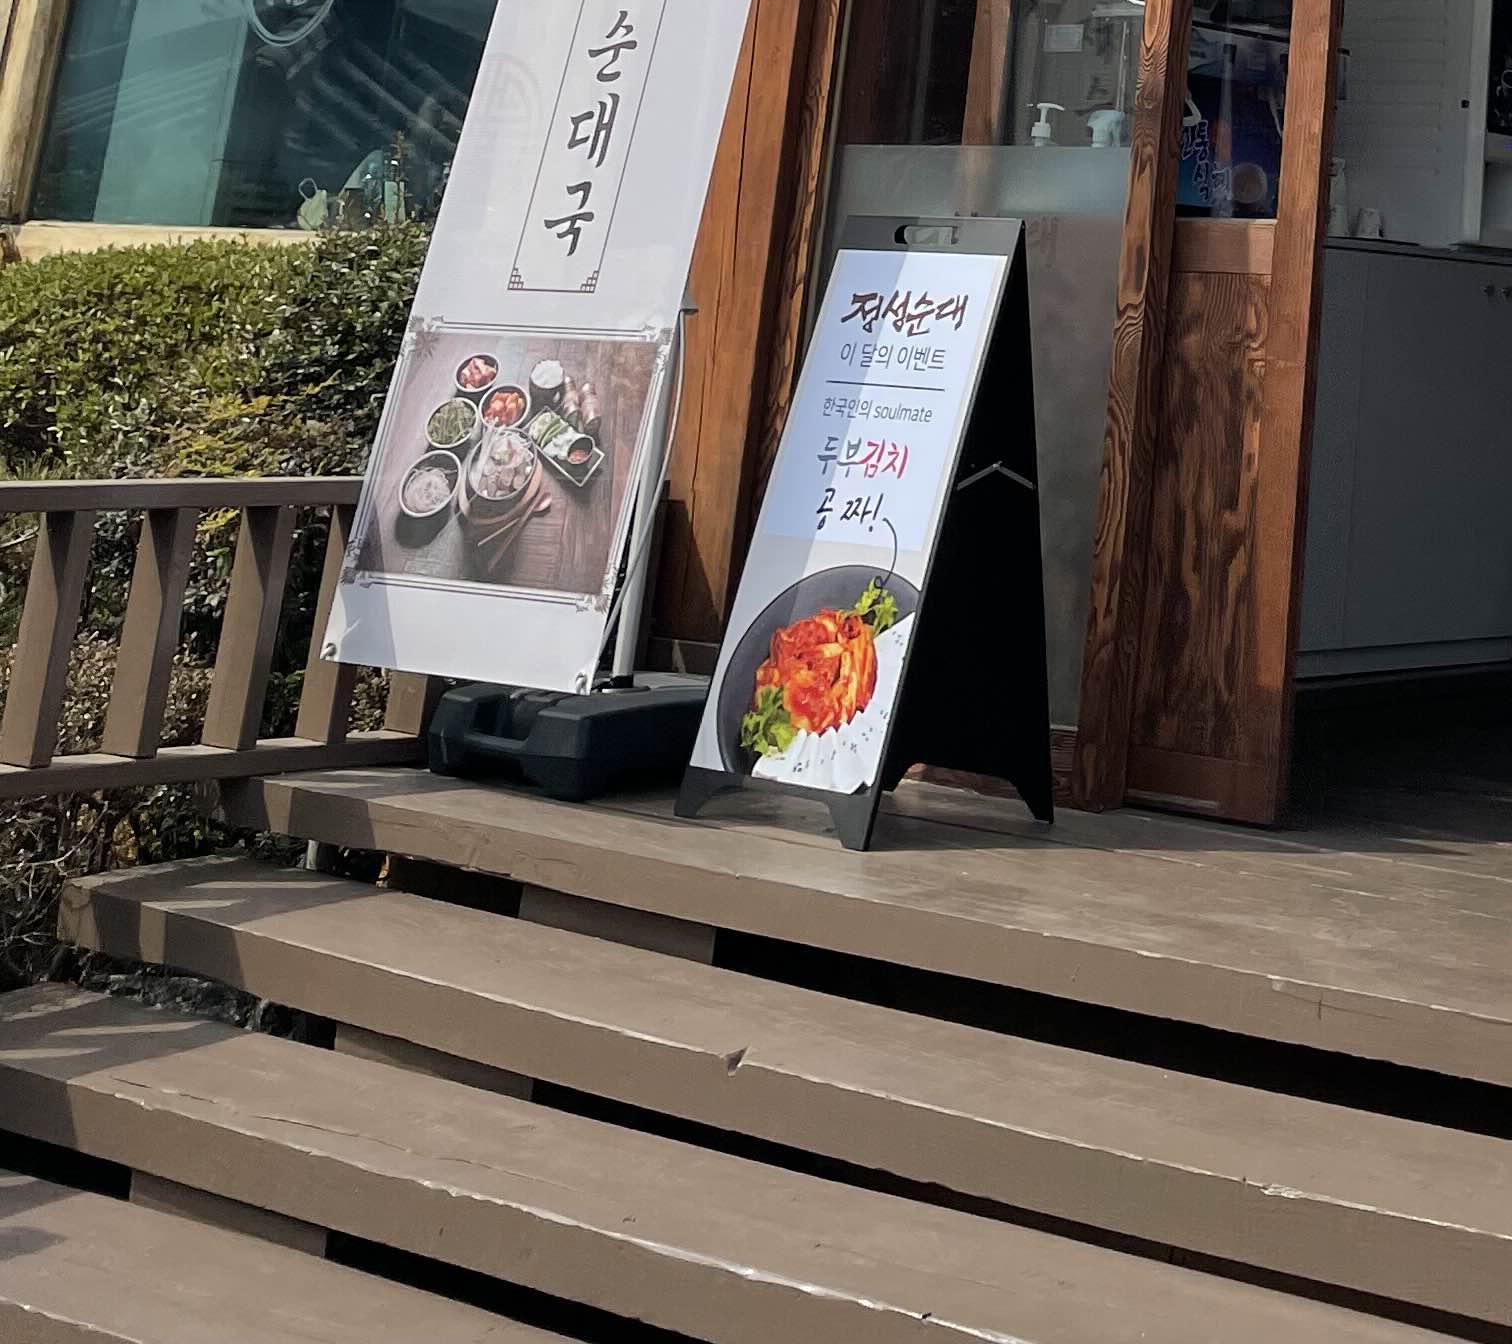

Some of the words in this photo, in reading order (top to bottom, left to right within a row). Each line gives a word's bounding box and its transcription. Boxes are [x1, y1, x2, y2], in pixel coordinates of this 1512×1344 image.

[841, 289, 969, 337] 정성순대
[840, 343, 857, 367] 이
[860, 343, 893, 370] 달의
[898, 345, 946, 372] 이벤트
[823, 397, 873, 420] 한국인의
[873, 402, 933, 423] soulmate
[817, 436, 909, 479] 두부김치
